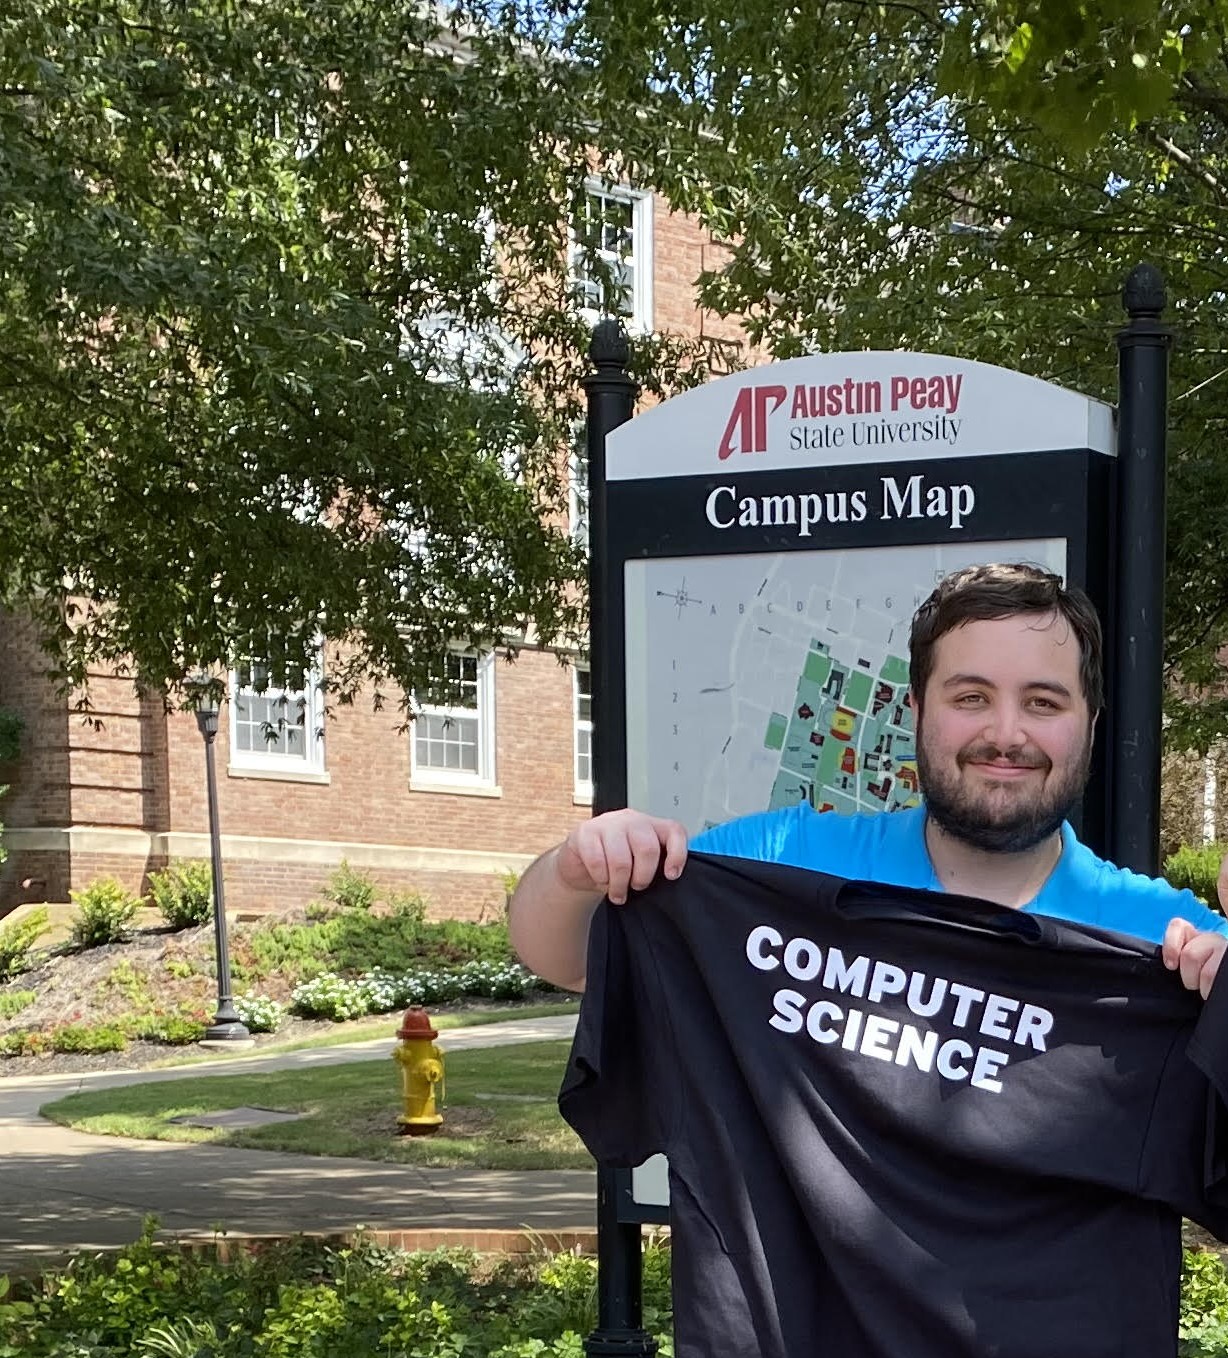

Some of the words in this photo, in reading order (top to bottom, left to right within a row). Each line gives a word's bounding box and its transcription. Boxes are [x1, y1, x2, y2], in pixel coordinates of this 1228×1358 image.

[791, 378, 881, 418] Austin
[891, 374, 962, 414] Peay
[790, 425, 844, 450] State
[852, 416, 961, 446] University
[706, 486, 866, 536] Campus
[881, 476, 974, 528] Map
[710, 604, 717, 615] A
[746, 926, 1054, 1052] COMPUTER
[769, 989, 1009, 1093] SCIENCE
